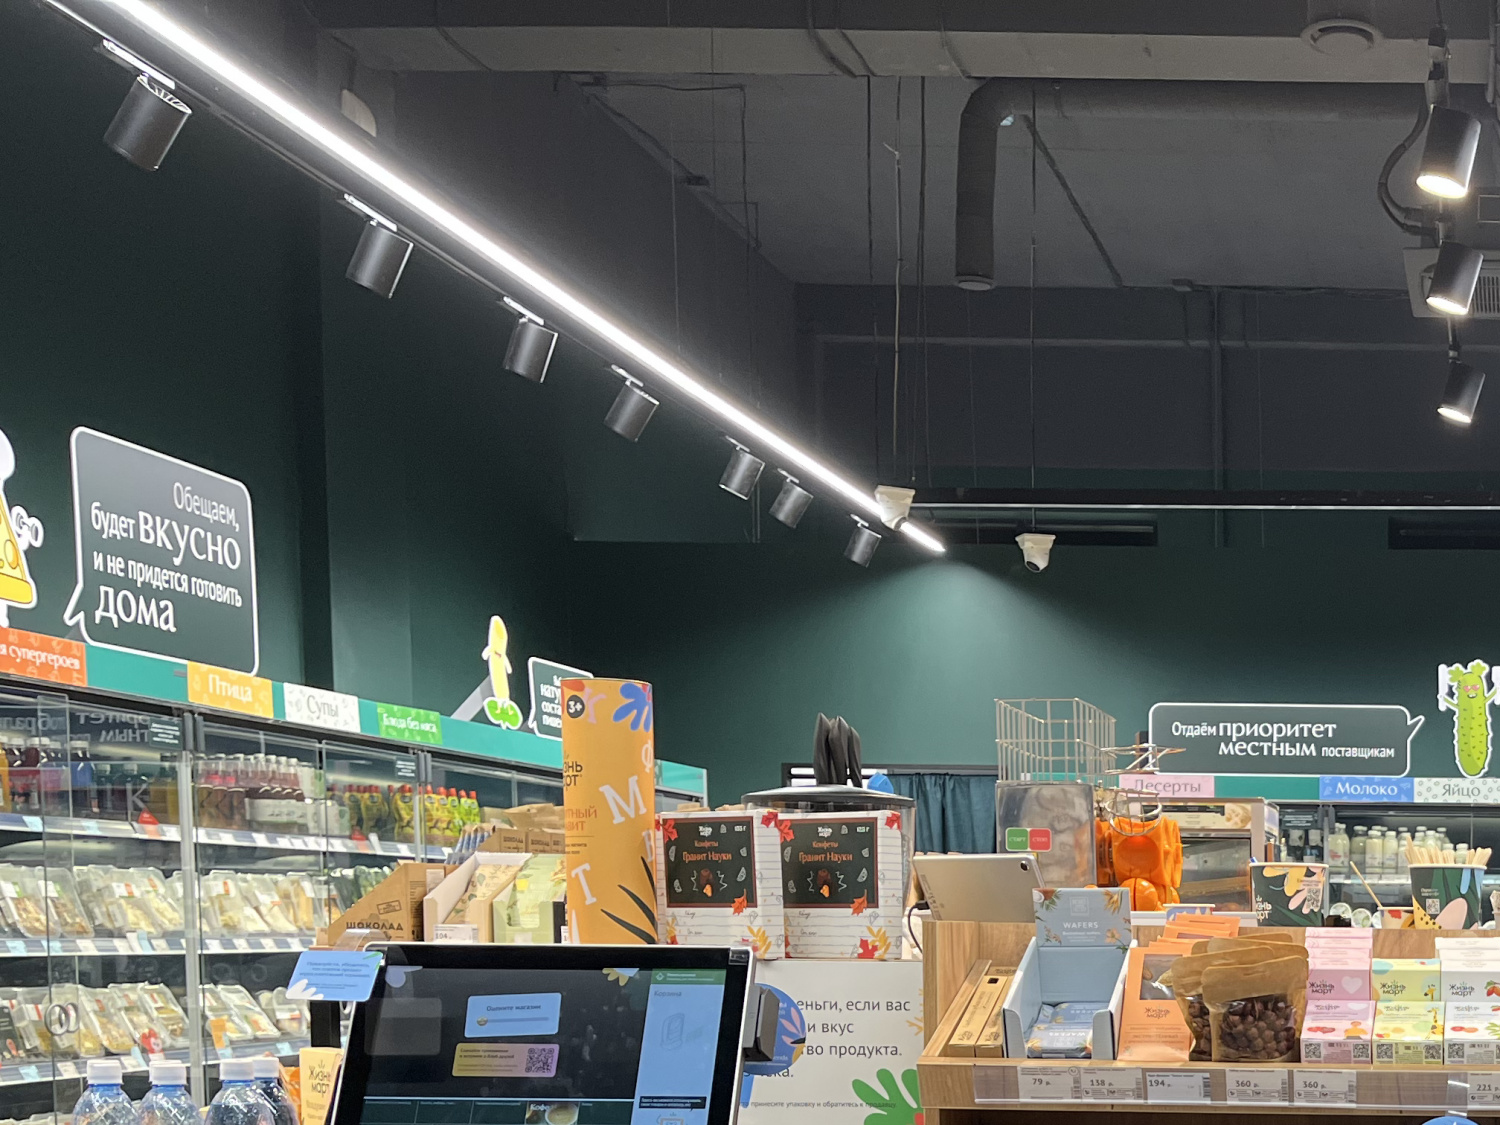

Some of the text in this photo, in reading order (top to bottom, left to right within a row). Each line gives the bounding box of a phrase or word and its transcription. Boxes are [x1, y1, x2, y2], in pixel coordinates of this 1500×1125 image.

[173, 482, 240, 531] Обещаем,
[91, 502, 136, 540] будет
[93, 551, 242, 608] и не придется готовить
[9, 646, 82, 670] супергероев
[208, 674, 253, 703] Птица
[306, 694, 340, 719] Супы
[567, 700, 583, 714] 3+
[1172, 720, 1336, 742] Отдаём приоритет
[1218, 740, 1394, 760] местным поставщикам
[1335, 781, 1398, 797] Молоко
[1442, 782, 1480, 800] Яйцо
[682, 852, 732, 863] Гранит Науки
[798, 852, 853, 864] Гранит Науки
[346, 921, 404, 932] ШОКОЛАД
[1063, 921, 1099, 929] WAFERS
[515, 1004, 542, 1012] магазин
[846, 1001, 911, 1011] если вас
[821, 1022, 854, 1036] вкус
[829, 1045, 902, 1058] продукта.
[1235, 1080, 1251, 1088] 360
[530, 1104, 550, 1112] Кофе
[822, 1100, 859, 1108] обратитесь
